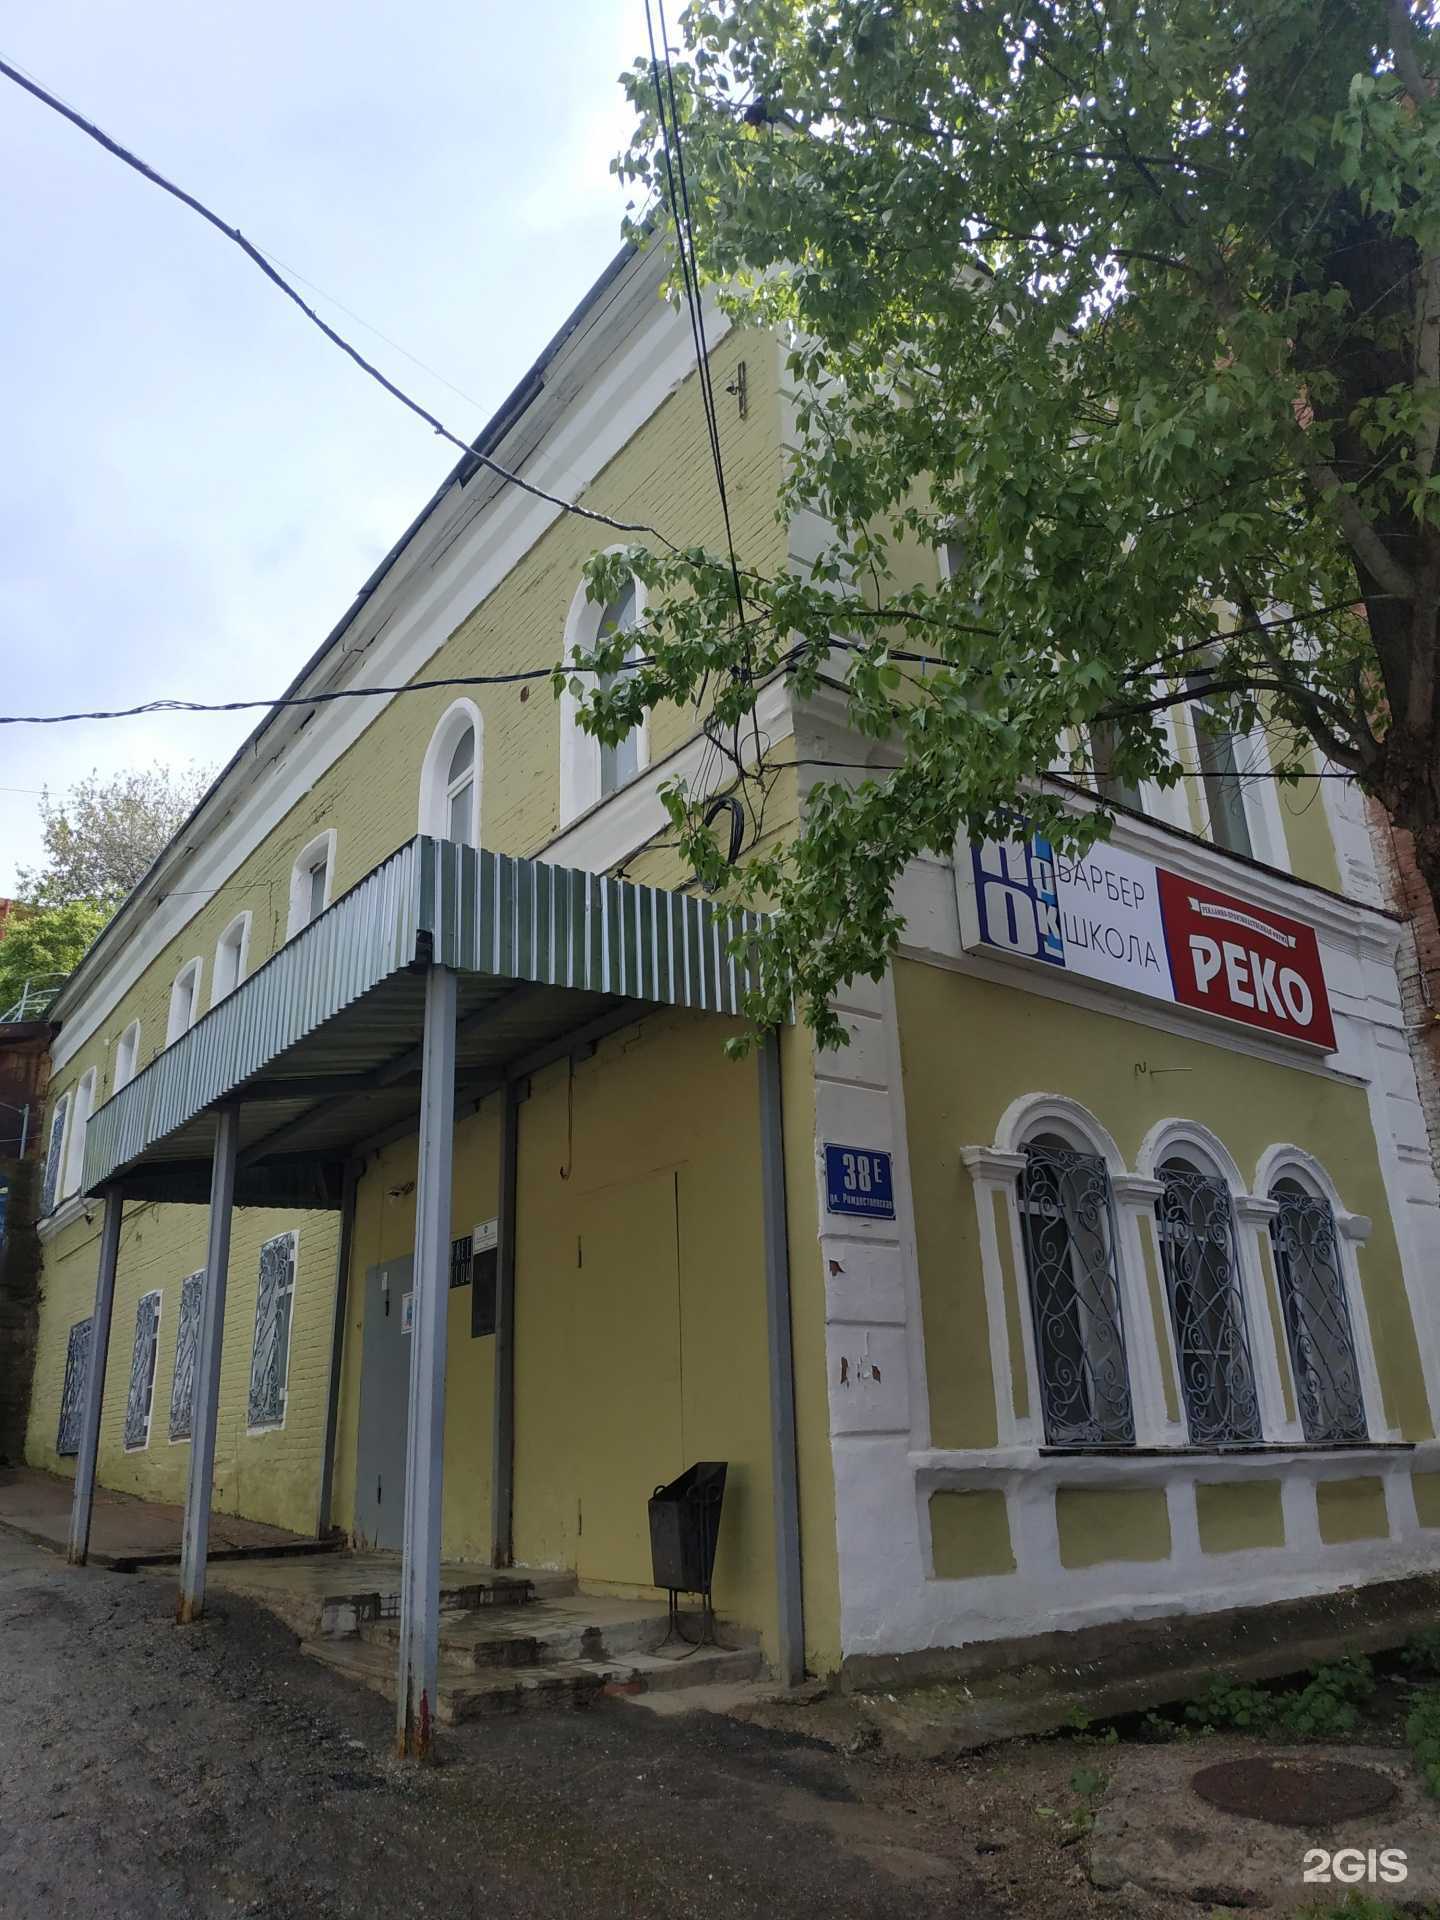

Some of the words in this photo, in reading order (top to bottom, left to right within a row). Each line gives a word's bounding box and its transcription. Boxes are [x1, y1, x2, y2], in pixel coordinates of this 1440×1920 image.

[1057, 856, 1145, 911] БАРБЕР
[1064, 916, 1160, 973] ШКОЛА
[1189, 935, 1314, 1027] РЕКО
